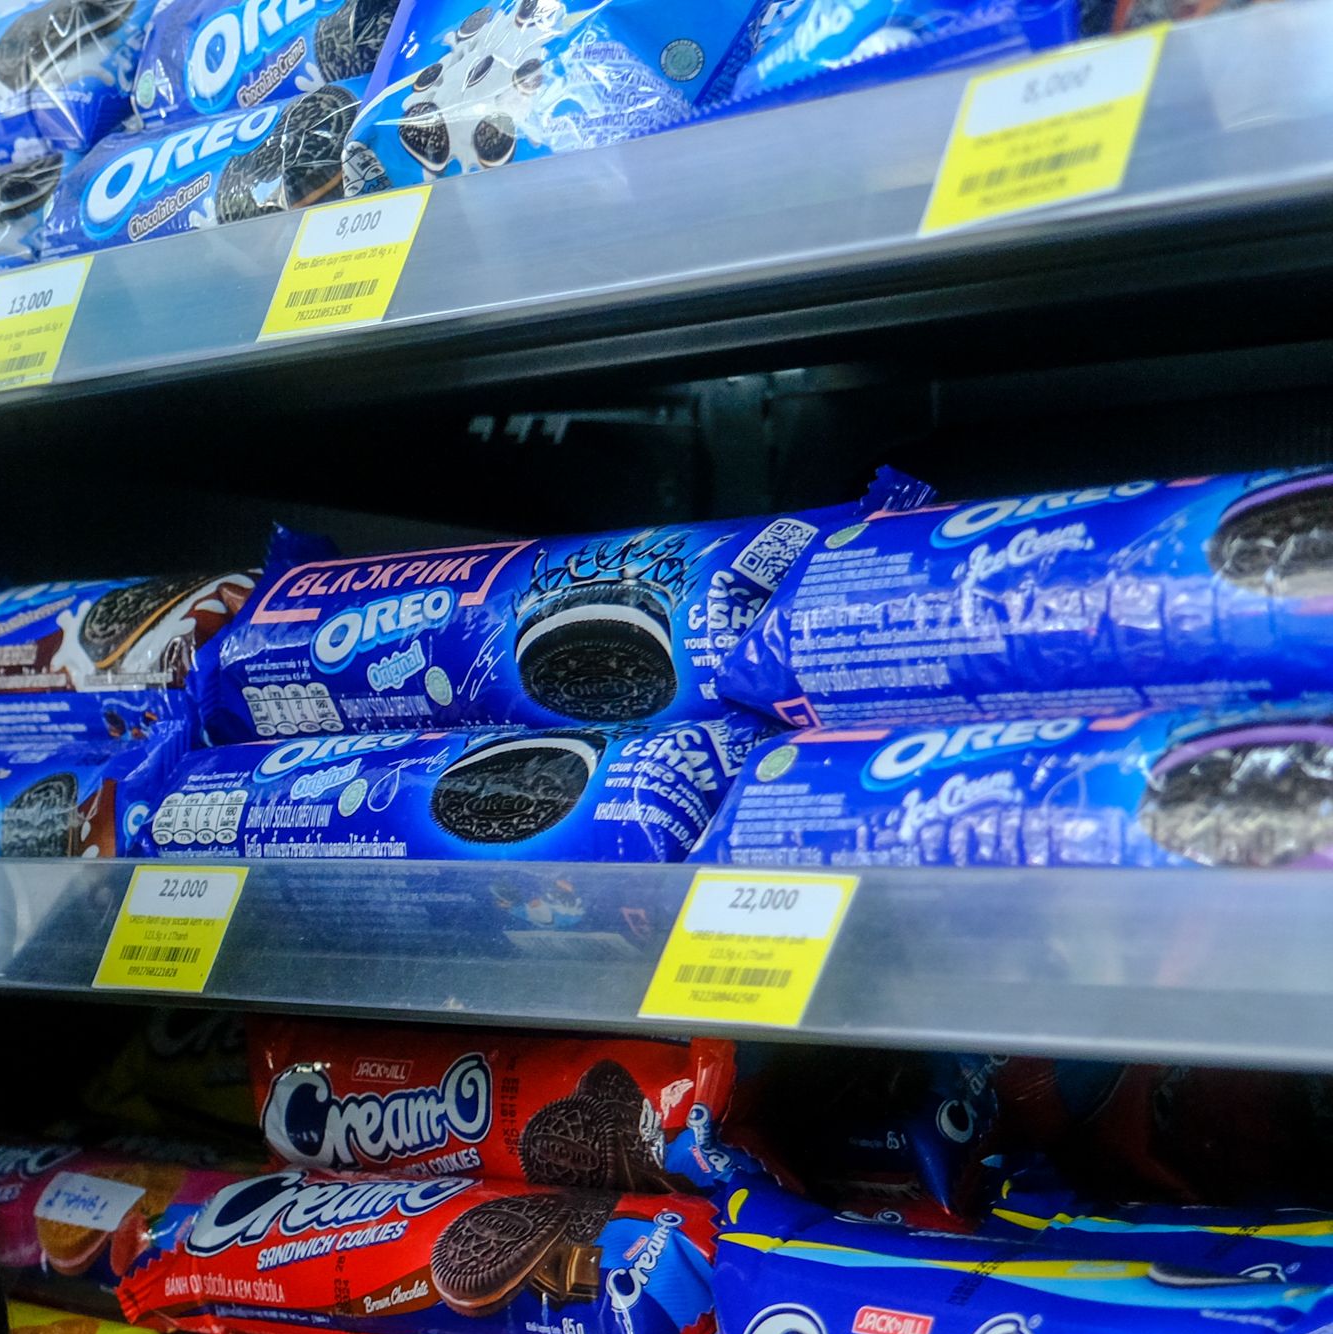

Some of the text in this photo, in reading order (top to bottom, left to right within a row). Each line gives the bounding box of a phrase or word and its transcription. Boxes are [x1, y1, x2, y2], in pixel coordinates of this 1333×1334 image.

[238, 37, 305, 106] Chocolate Creme
[86, 105, 279, 224] OREO
[130, 173, 211, 239] Chocolate Creme
[336, 209, 382, 240] 8,000
[7, 288, 53, 316] 13,000
[941, 481, 1156, 539] OREO
[286, 554, 490, 598] BLACKPINK
[314, 590, 452, 664] OREO
[369, 641, 424, 688] Original
[260, 733, 412, 775] OREO
[656, 728, 718, 792] CAN
[870, 718, 1084, 780] OREO
[292, 760, 360, 798] Original
[159, 879, 209, 901] 22,000
[728, 887, 800, 913] 22,000
[429, 1147, 482, 1176] COOKIES
[256, 1219, 409, 1271] SANDWICH COOKIES
